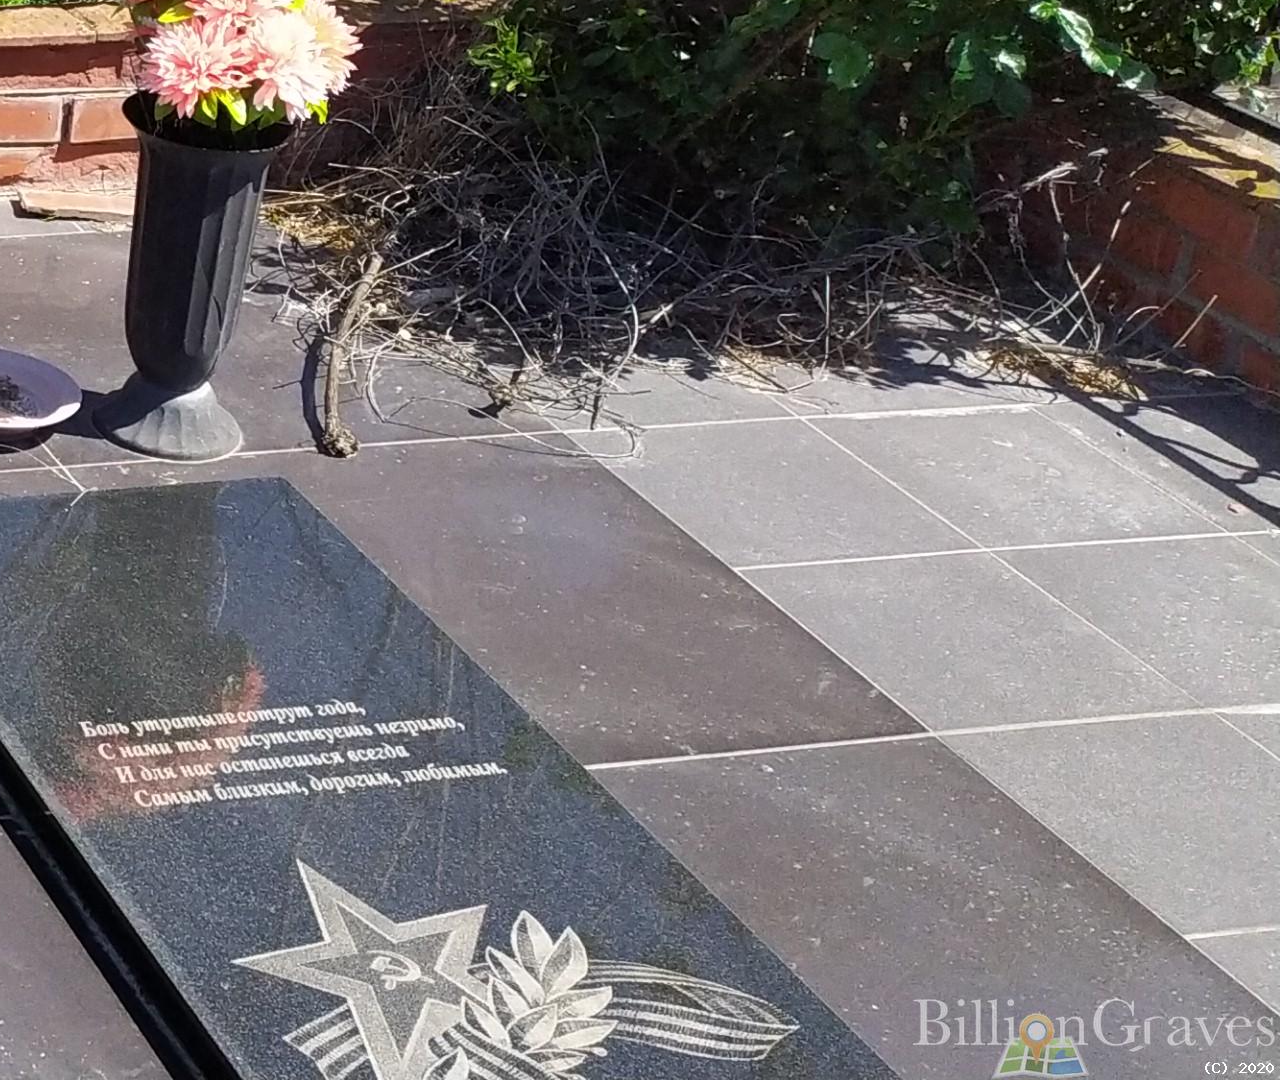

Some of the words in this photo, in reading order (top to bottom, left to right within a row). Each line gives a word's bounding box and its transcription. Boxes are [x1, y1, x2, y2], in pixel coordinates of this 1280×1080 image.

[79, 720, 130, 737] Боль
[315, 699, 366, 716] года,
[97, 742, 116, 760] С
[119, 742, 174, 758] нами
[175, 738, 212, 754] ты
[214, 724, 374, 753] присутствуешь
[374, 716, 466, 736] незримо,
[114, 765, 137, 784] И
[139, 764, 178, 782] для
[179, 763, 217, 778] нас
[220, 751, 345, 774] останешься
[347, 743, 410, 763] всегда
[134, 785, 214, 809] Самым
[214, 778, 309, 800] близким,
[307, 770, 402, 794] дорогим,
[401, 762, 508, 783] любимым.
